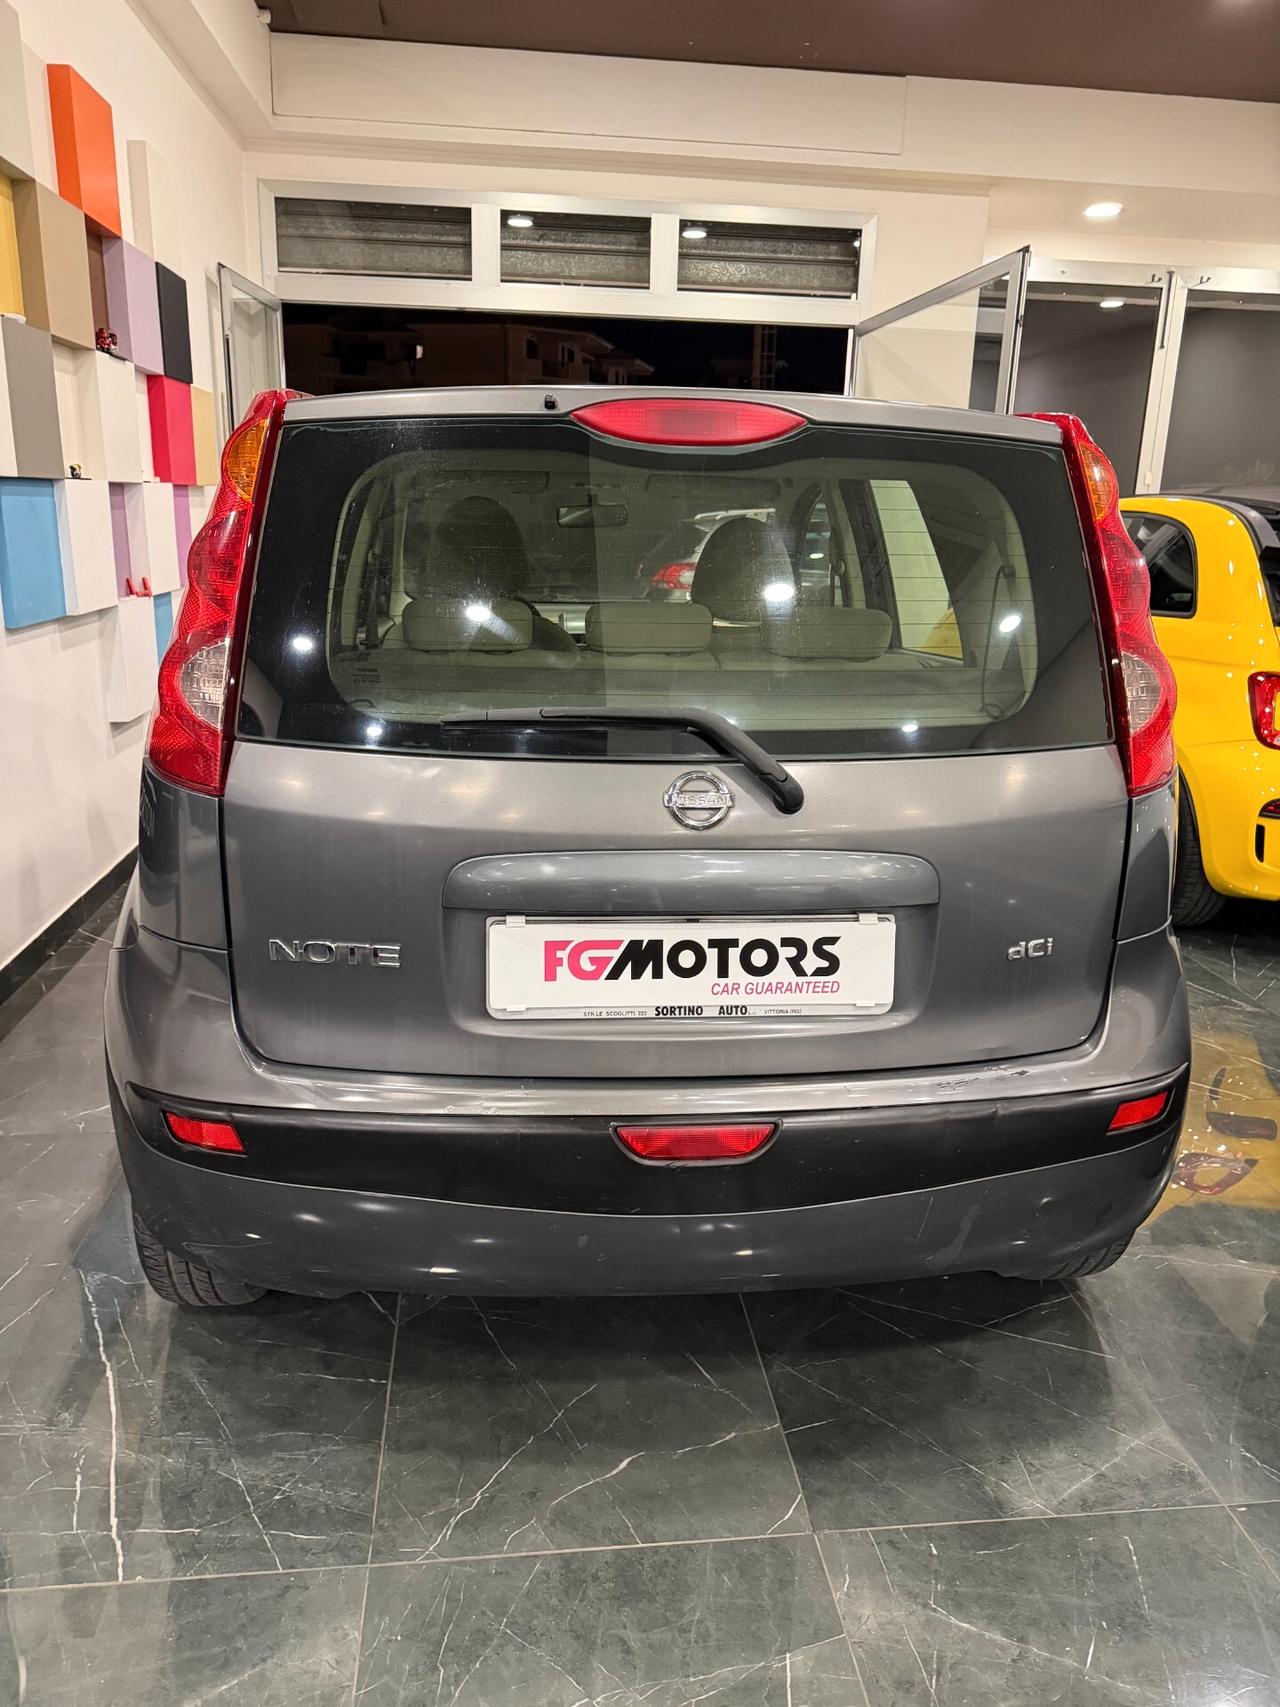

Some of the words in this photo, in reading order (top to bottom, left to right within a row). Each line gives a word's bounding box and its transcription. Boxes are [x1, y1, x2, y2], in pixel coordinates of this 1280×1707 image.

[672, 793, 727, 806] NISSAN
[268, 939, 401, 967] NOTE
[1007, 937, 1054, 960] dCi
[711, 982, 741, 996] CAR
[744, 980, 841, 995] GUARANTEED
[654, 1005, 704, 1017] SORTINO
[718, 1005, 748, 1016] AUTO
